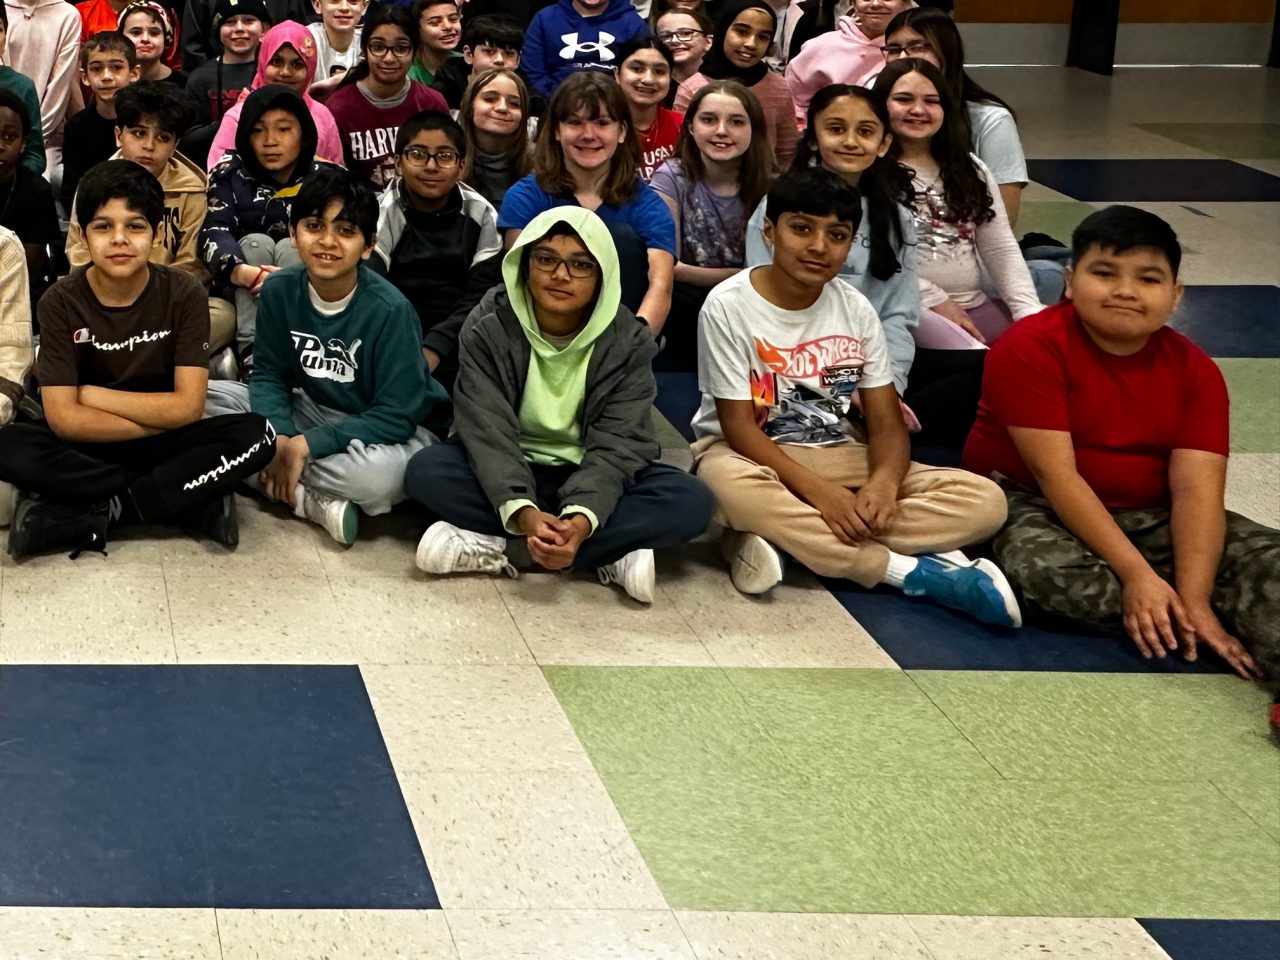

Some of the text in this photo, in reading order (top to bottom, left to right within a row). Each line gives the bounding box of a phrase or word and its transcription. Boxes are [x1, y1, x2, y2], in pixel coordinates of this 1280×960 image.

[349, 126, 400, 161] HARV
[73, 327, 171, 351] Champion
[290, 331, 355, 383] Puma
